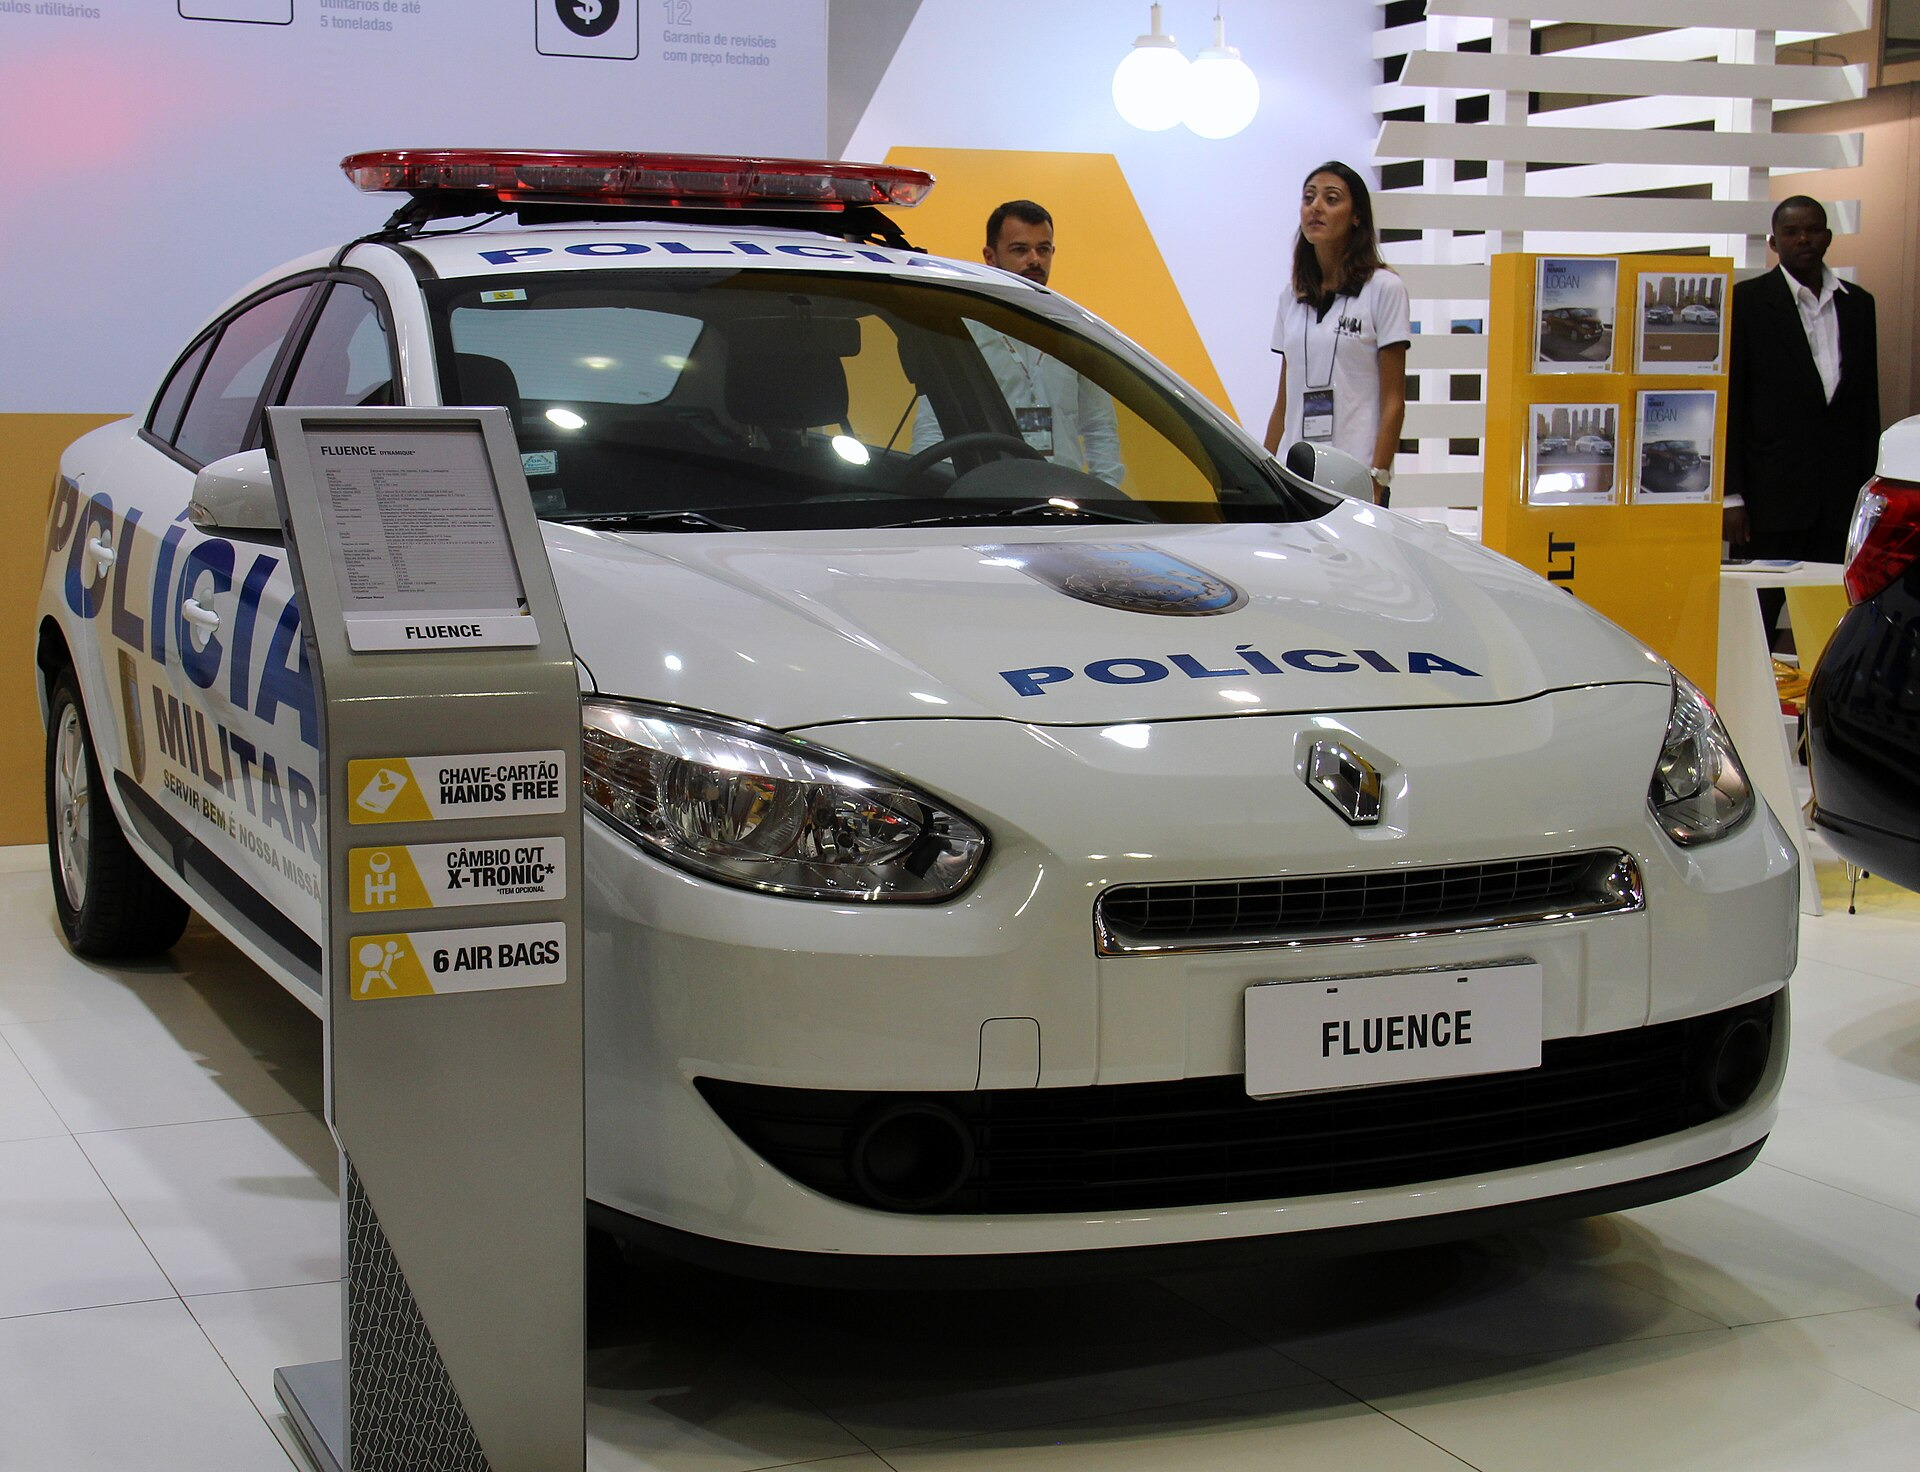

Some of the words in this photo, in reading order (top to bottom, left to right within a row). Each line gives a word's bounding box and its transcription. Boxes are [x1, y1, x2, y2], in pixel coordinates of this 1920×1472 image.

[35, 3, 101, 18] utilitários
[383, 0, 398, 12] de
[401, 1, 421, 14] até
[663, 0, 692, 26] 12
[320, 15, 328, 27] 5
[332, 16, 393, 31] toneladas
[663, 30, 711, 45] Garantia
[713, 33, 728, 46] de
[730, 35, 777, 49] revisões
[663, 50, 688, 62] com
[690, 52, 722, 66] preço
[725, 52, 770, 66] fechado
[477, 240, 984, 277] POLÍCIA
[1546, 274, 1580, 289] LOGAN
[1646, 409, 1678, 423] LOGAN
[320, 446, 377, 456] FLUENCE
[1548, 532, 1576, 595] LT
[50, 474, 321, 752] POLÍCIA
[405, 623, 483, 639] FLUENCE
[998, 643, 1483, 697] POLÍCIA
[152, 684, 323, 866] MILITAR
[438, 761, 559, 785] CHAVE-CARTÃO
[440, 784, 506, 805] HANDS
[512, 780, 559, 801] FREE
[163, 768, 200, 812] SERVIR
[202, 796, 226, 831] BEM
[228, 810, 236, 839] É
[239, 823, 281, 872] NOSSA
[282, 855, 323, 904] MISSÃ
[446, 848, 511, 868] CÂMBIO
[514, 847, 545, 865] CVT
[515, 886, 545, 895] OPCIONAL
[433, 949, 449, 974] 6
[453, 945, 493, 971] AIR
[498, 940, 560, 970] BAGS
[1322, 1010, 1472, 1058] FLUENCE
